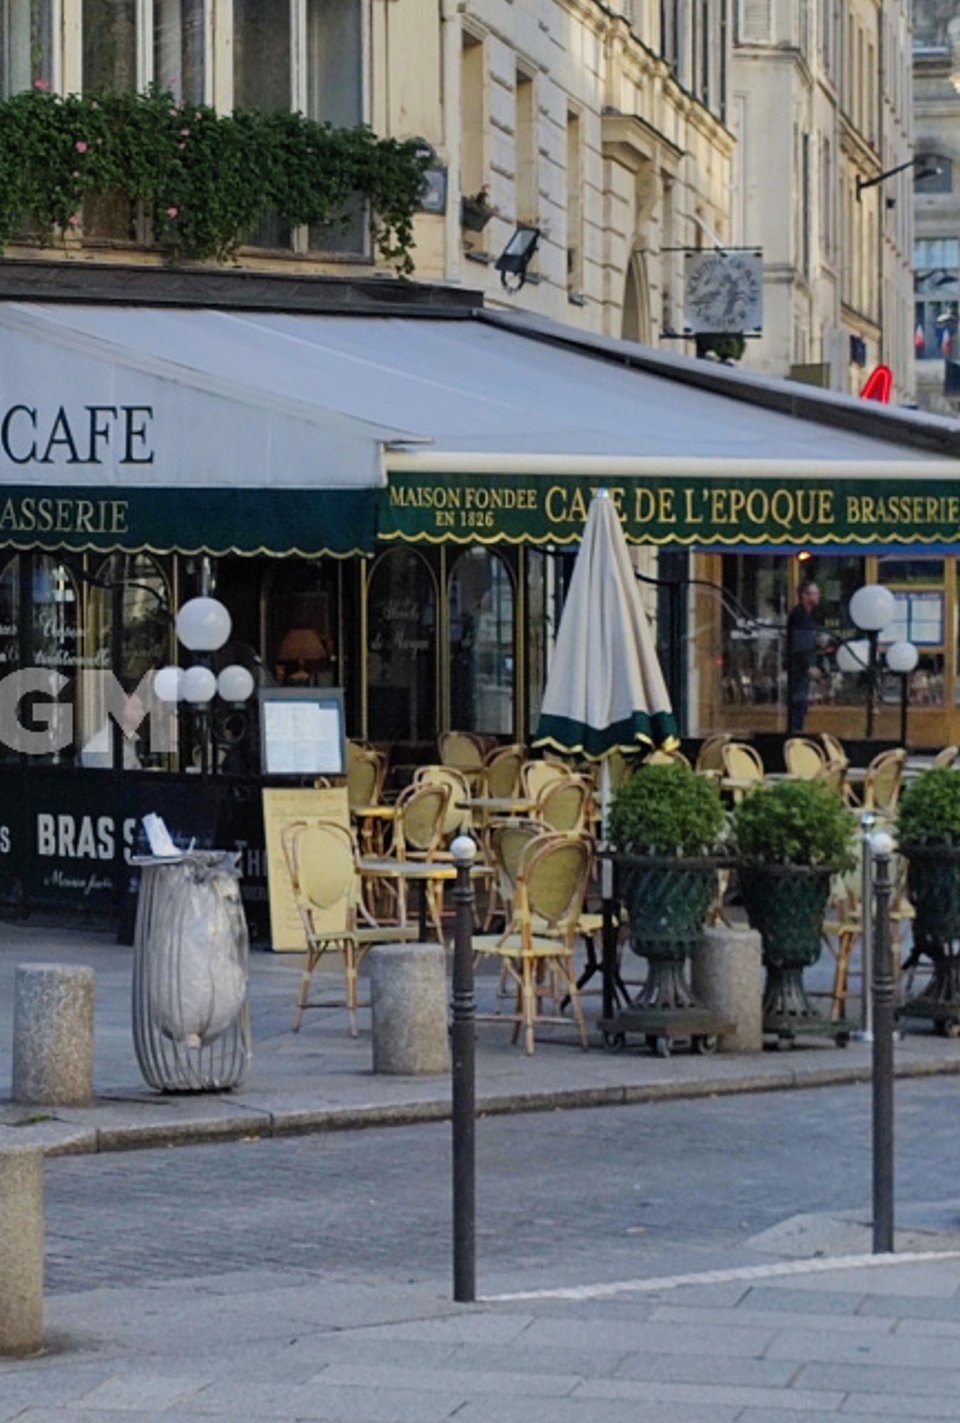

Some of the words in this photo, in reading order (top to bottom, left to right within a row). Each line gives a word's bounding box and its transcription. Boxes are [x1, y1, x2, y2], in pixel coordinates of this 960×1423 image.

[0, 403, 156, 465] CAFE
[390, 487, 460, 508] MAISON
[465, 489, 538, 510] FONDEE
[635, 487, 677, 523] DE
[685, 488, 834, 528] L'EPOQUE
[846, 496, 959, 524] BRASSERIE
[436, 512, 455, 526] EN
[460, 511, 494, 527] 1826
